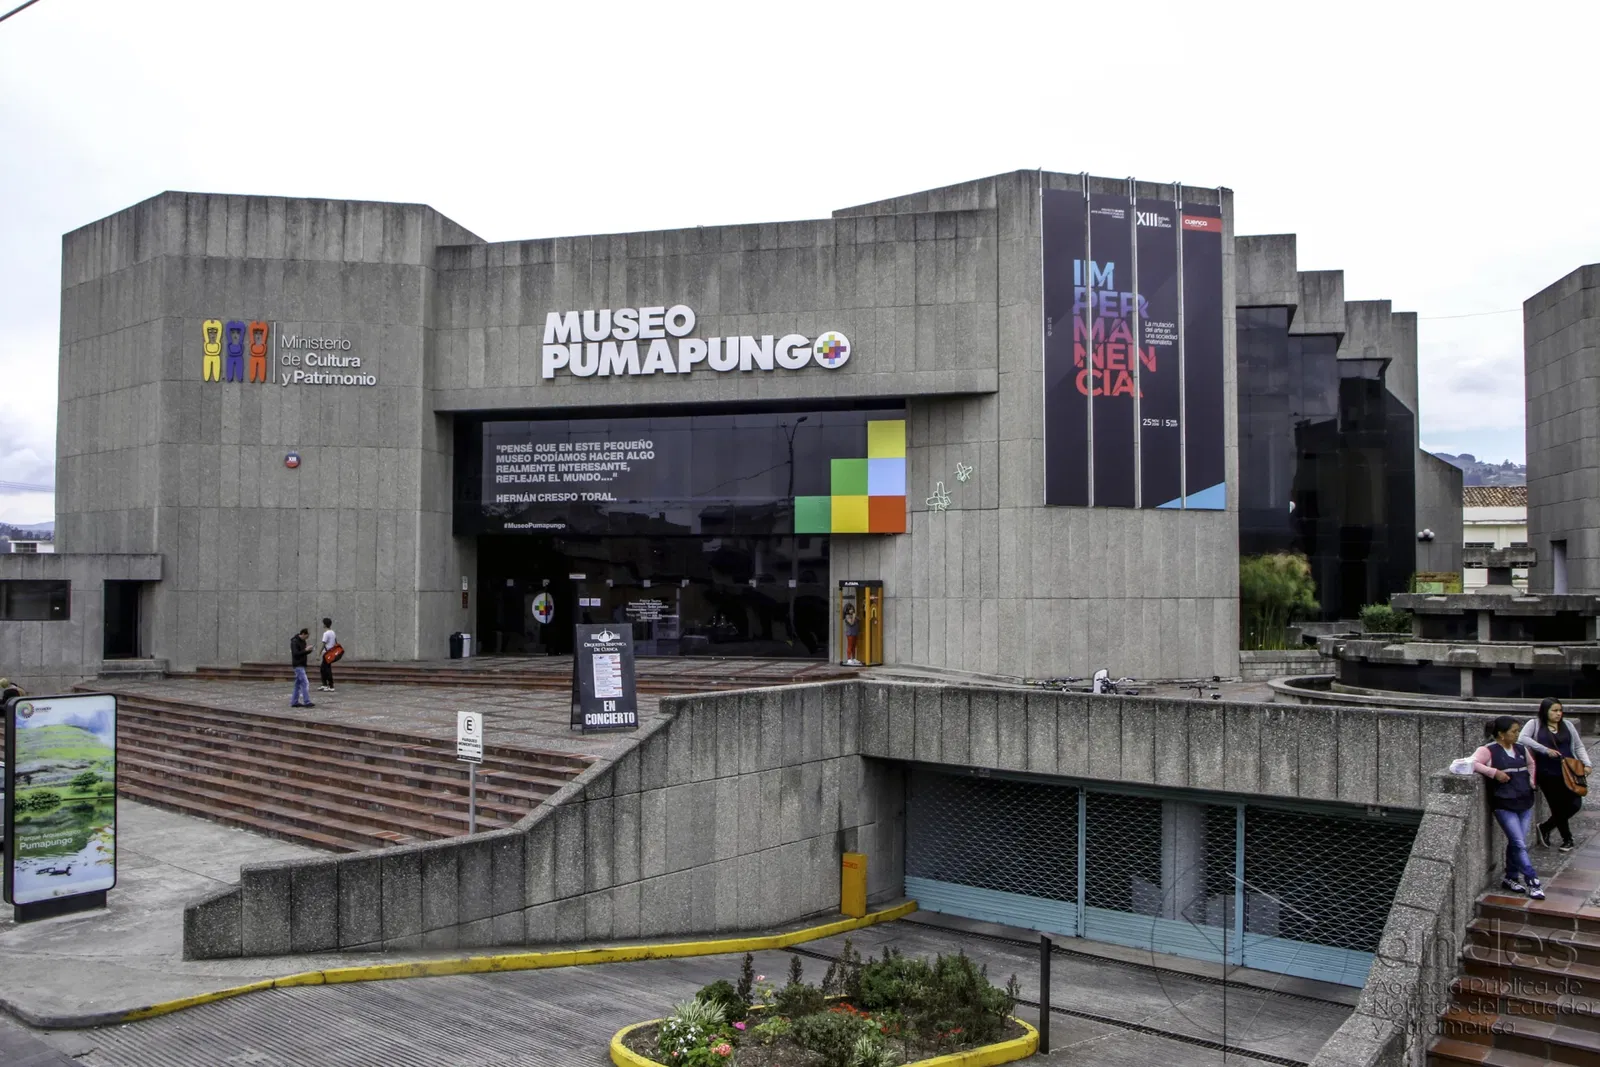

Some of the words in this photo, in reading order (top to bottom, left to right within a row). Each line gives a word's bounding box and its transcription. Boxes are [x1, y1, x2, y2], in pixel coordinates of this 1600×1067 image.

[1137, 211, 1157, 227] XIII
[543, 304, 696, 344] MUSEO
[281, 334, 351, 350] Ministerio
[281, 352, 300, 366] de
[305, 352, 361, 367] Cultura
[542, 331, 851, 379] PUMAPUNGO
[281, 372, 291, 387] y
[293, 370, 377, 386] Patrimonio
[1143, 418, 1151, 426] 25
[1166, 419, 1171, 427] 5
[496, 442, 533, 453] "PENSÉ
[535, 443, 557, 453] QUE
[558, 443, 573, 451] EN
[575, 442, 601, 451] ESTE
[603, 439, 653, 450] PEQUEÑO
[496, 454, 531, 463] MUSEO
[533, 452, 587, 463] PODÍAMOS
[589, 452, 624, 461] HACER
[626, 451, 655, 460] ALGO
[496, 464, 556, 473] REALMENTE
[558, 462, 631, 472] INTERESANTE,
[496, 474, 546, 483] REFLEJAR
[548, 474, 561, 482] EL
[496, 491, 537, 503] HERNÁN
[538, 493, 578, 502] CRESPO
[580, 492, 617, 501] TORAL.
[504, 522, 566, 530] #MuseoPumapungo
[603, 700, 616, 712] EN
[585, 711, 636, 725] CONCIERTO
[466, 719, 473, 731] E
[19, 837, 73, 850] Pumapungo
